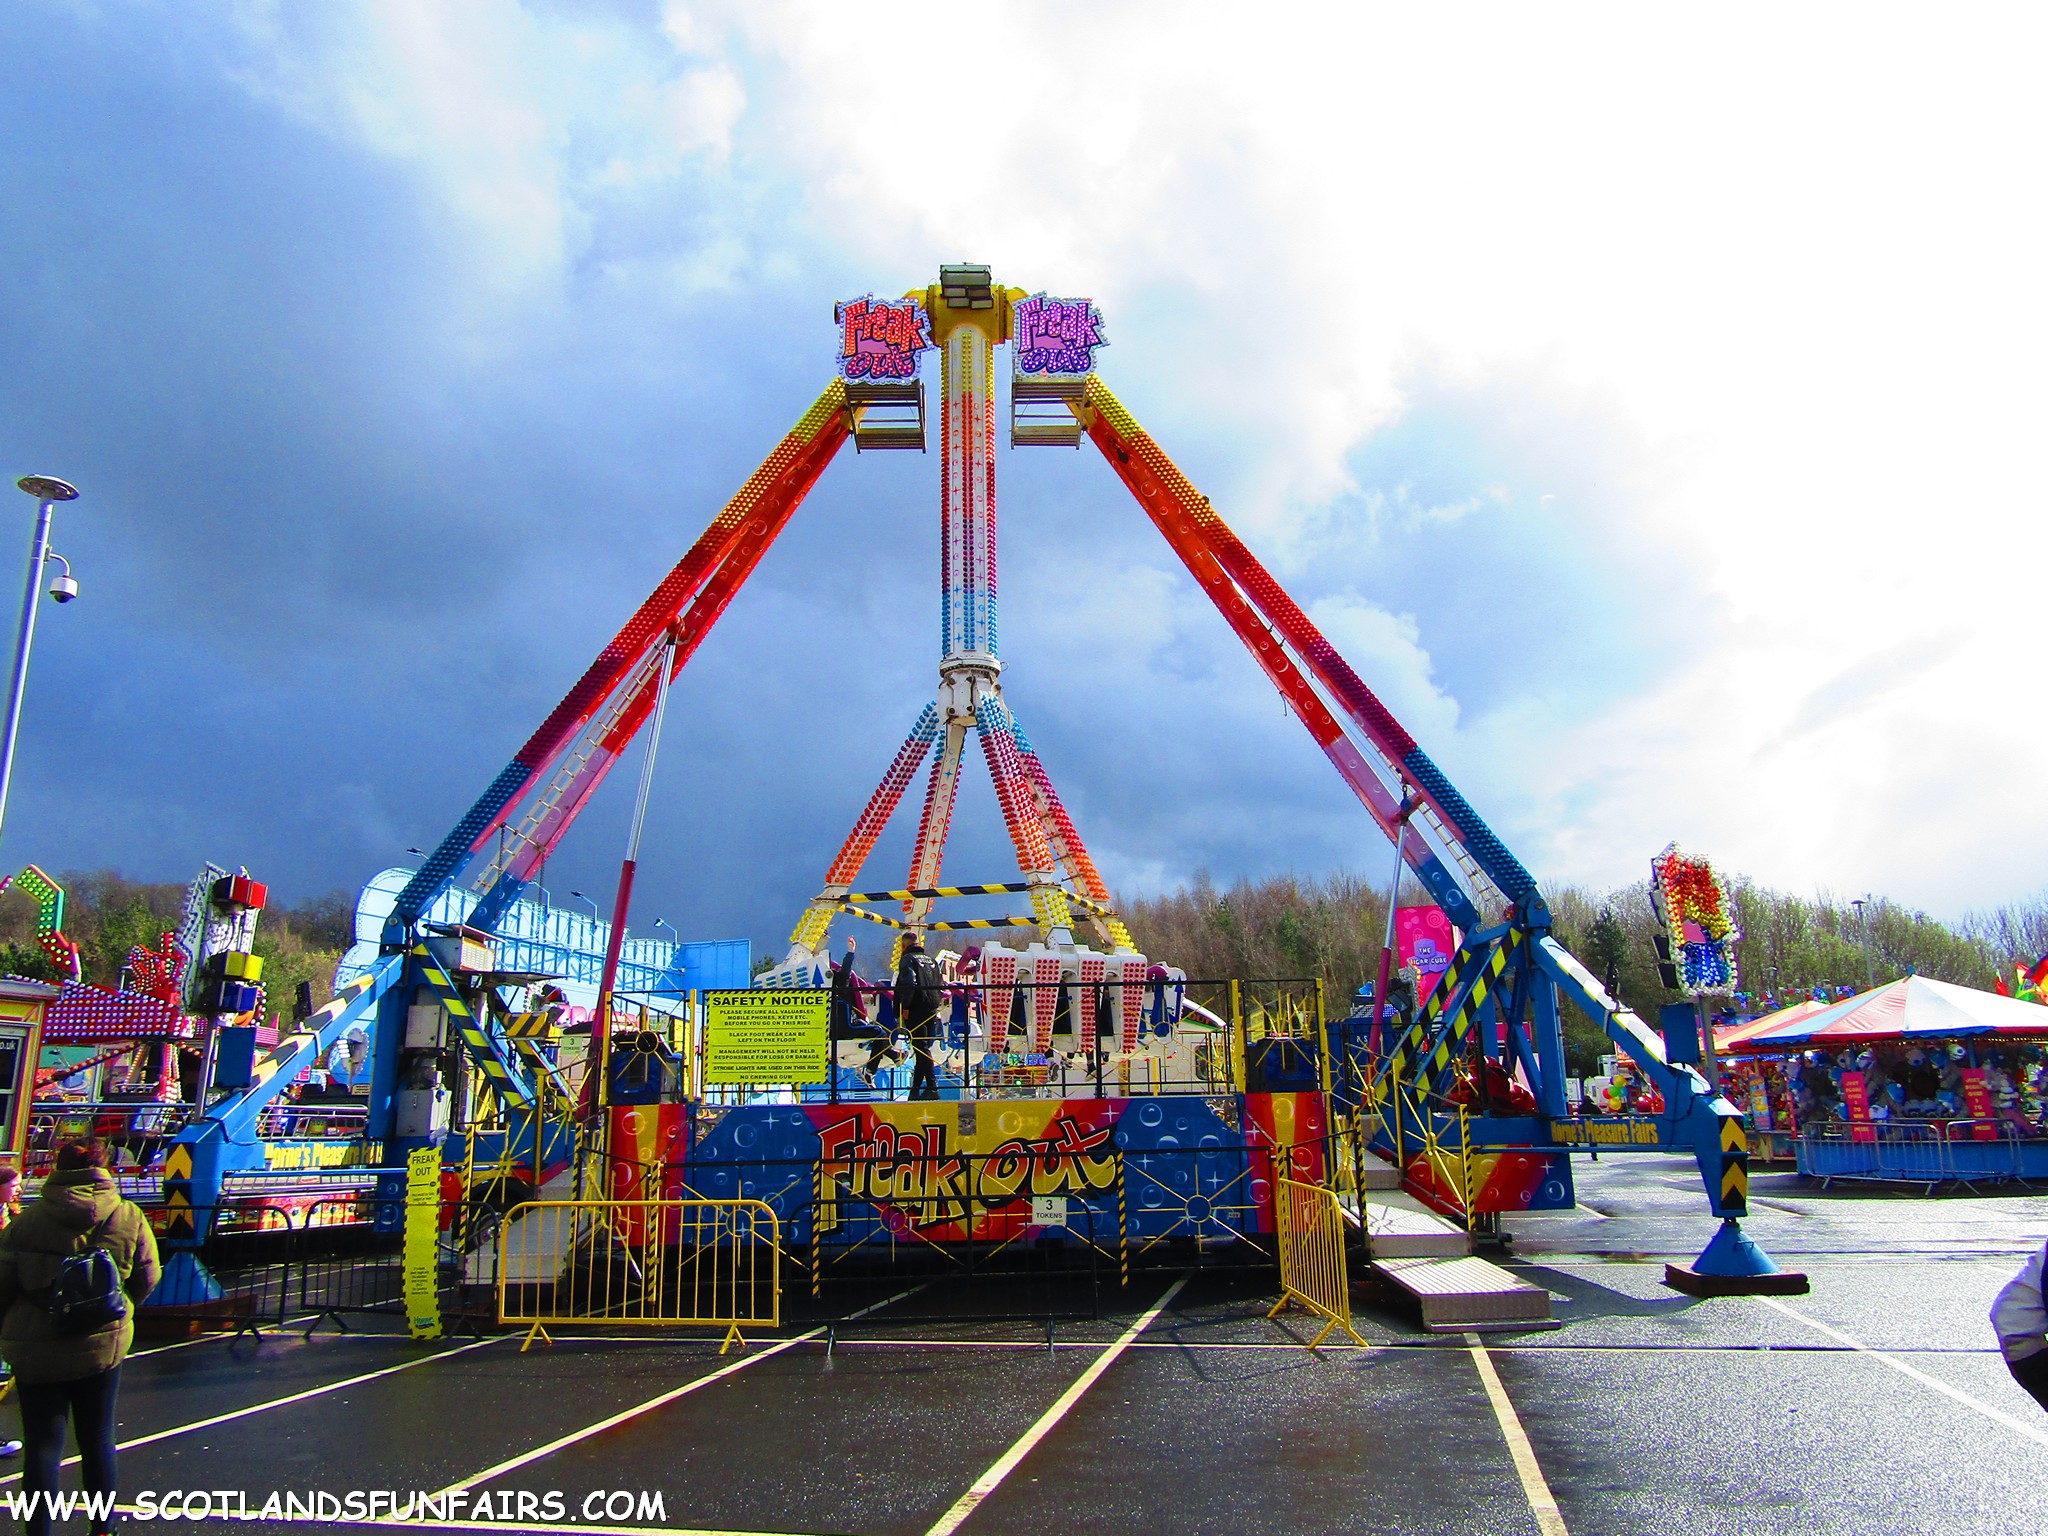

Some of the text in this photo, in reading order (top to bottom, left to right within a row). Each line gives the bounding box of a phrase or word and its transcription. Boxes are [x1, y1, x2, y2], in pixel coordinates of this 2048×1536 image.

[843, 299, 925, 357] Freak
[1018, 298, 1101, 353] Freak
[713, 997, 766, 1005] SAFETY
[1630, 1120, 1658, 1143] Fairs
[313, 1144, 359, 1166] Pleasure
[412, 1155, 436, 1164] FREAK
[416, 1167, 431, 1176] OUT
[815, 1113, 966, 1235] Freak
[1046, 1200, 1053, 1210] 3
